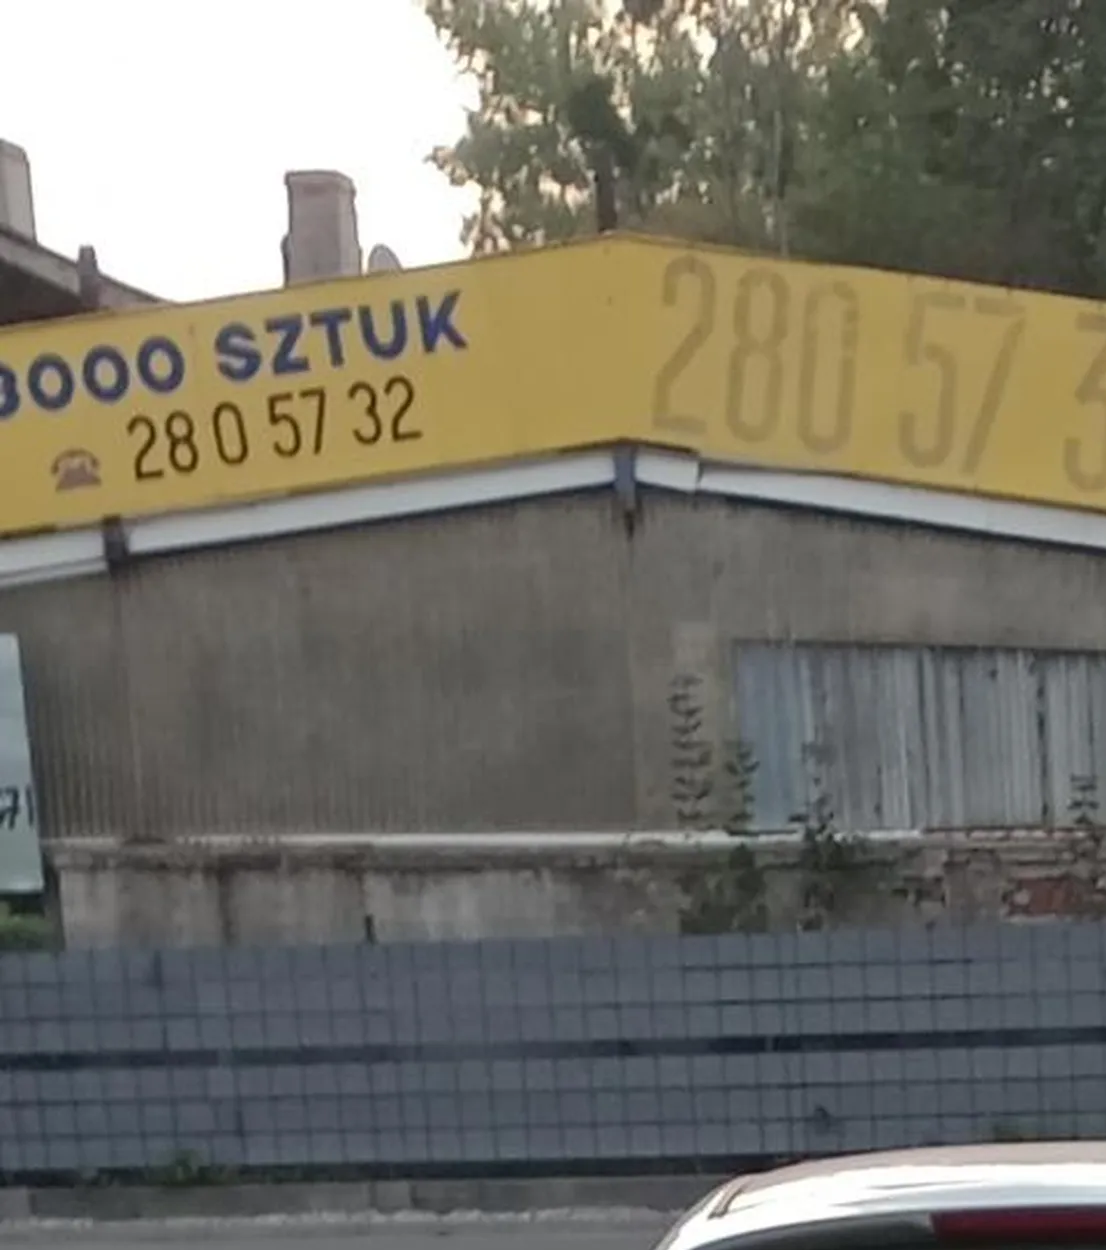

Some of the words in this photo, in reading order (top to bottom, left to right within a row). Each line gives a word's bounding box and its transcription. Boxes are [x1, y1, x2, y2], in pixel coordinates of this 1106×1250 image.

[214, 290, 467, 382] SZTUK
[651, 254, 857, 455] 280
[901, 292, 1026, 475] 57
[266, 386, 327, 457] 57
[347, 375, 423, 445] 32
